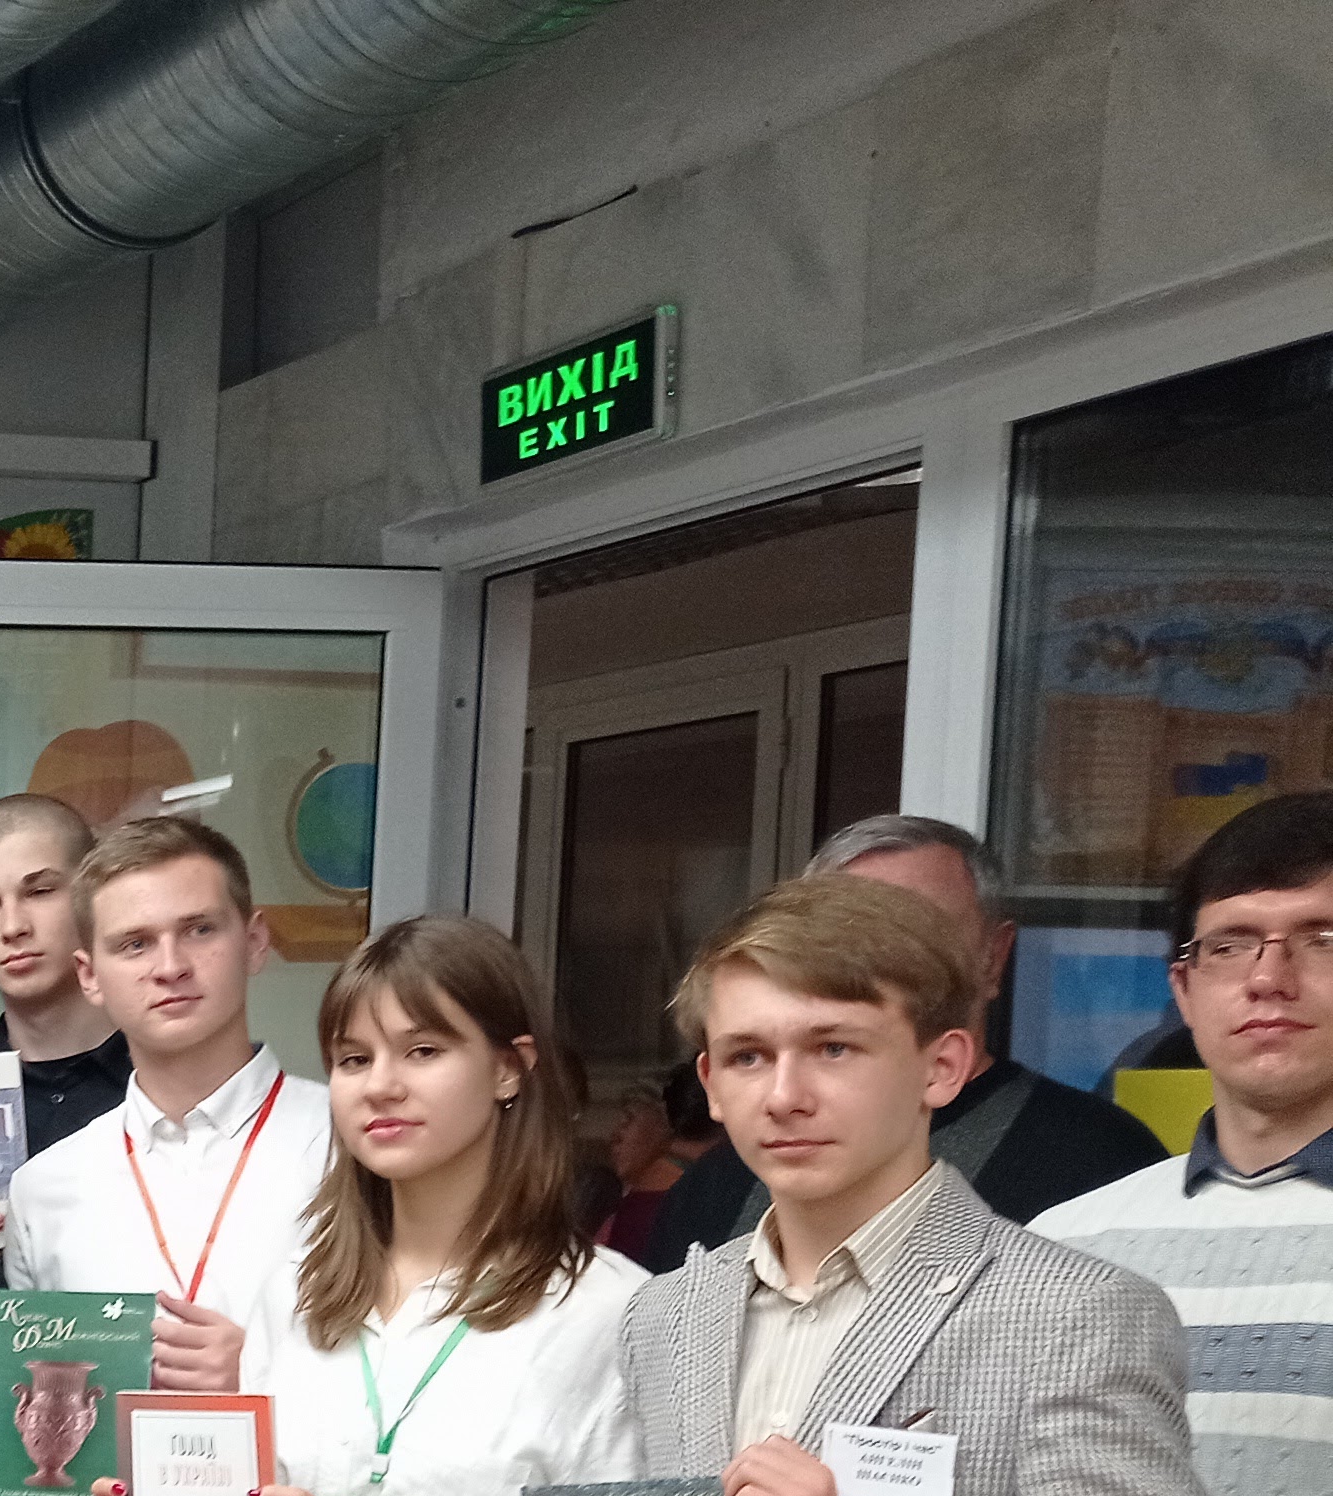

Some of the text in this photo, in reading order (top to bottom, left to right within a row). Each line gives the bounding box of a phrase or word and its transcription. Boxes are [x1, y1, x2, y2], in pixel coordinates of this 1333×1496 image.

[498, 339, 639, 427] ВИХІД
[519, 401, 615, 459] EXIT
[171, 1434, 217, 1459] ГОЛОД
